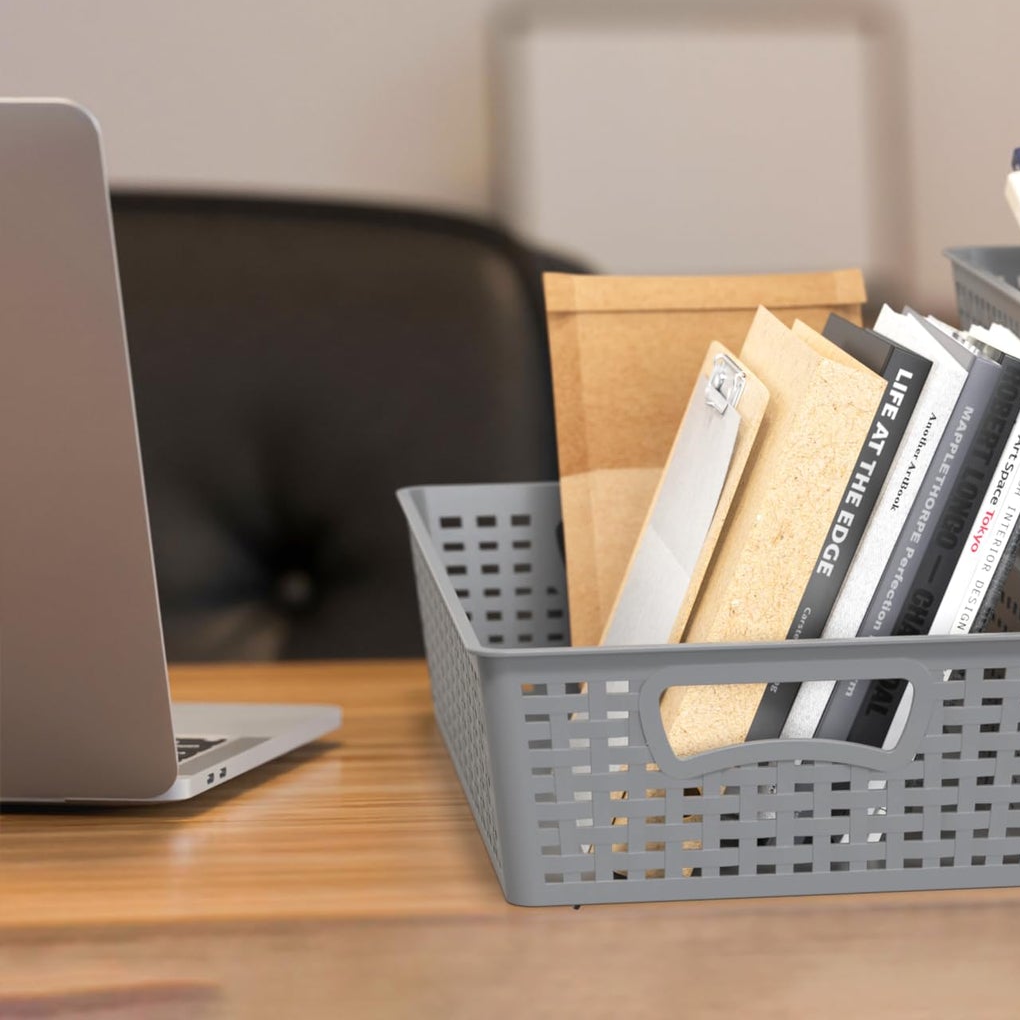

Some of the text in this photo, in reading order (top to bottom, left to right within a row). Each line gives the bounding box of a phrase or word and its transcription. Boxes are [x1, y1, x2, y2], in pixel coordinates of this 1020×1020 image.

[913, 412, 937, 462] Another
[816, 368, 914, 577] LIFE AT THE EDGE
[990, 462, 1015, 506] Space
[873, 405, 975, 631] MAPPLETHORPE Perfection
[935, 467, 986, 551] LONGO
[971, 509, 996, 553] Tokyo
[981, 505, 1017, 572] INTERIOR
[793, 606, 812, 639] Carste
[956, 580, 985, 631] DESIGN
